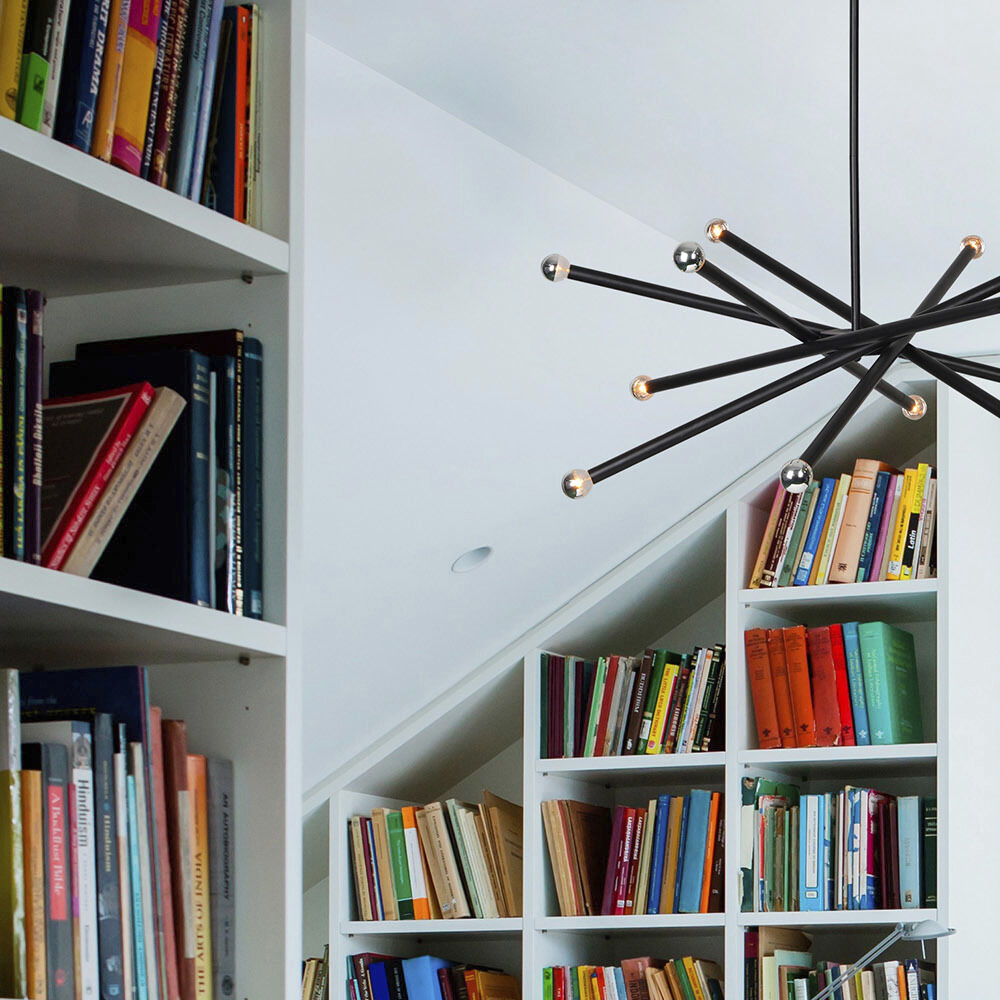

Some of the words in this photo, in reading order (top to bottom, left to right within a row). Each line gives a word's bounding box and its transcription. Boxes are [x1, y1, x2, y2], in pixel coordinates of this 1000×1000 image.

[88, 30, 105, 95] DRAMA
[905, 529, 919, 549] Latin
[51, 792, 60, 802] A
[222, 793, 228, 808] AN
[75, 779, 92, 847] Hinduism
[222, 811, 230, 901] AUTOBIOGRAPHY
[193, 851, 203, 896] INDIA
[195, 902, 203, 919] OF
[196, 923, 204, 960] ARTS
[197, 968, 205, 992] THE
